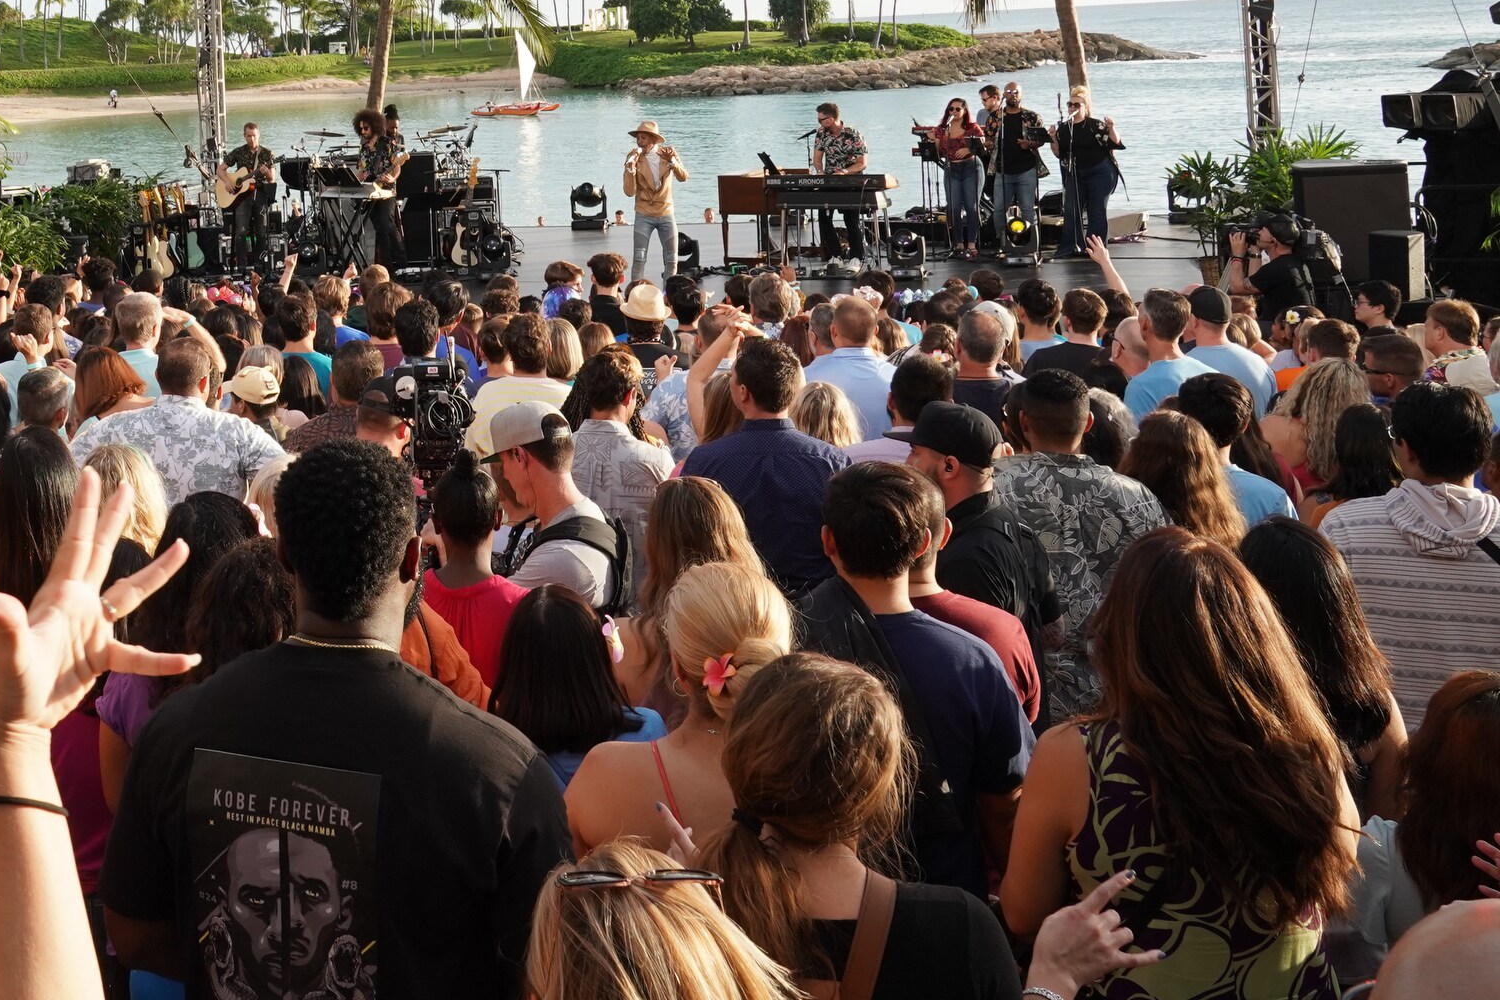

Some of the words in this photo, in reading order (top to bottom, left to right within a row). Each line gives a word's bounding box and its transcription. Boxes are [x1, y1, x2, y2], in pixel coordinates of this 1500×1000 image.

[213, 788, 257, 812] KOBE
[269, 796, 350, 827] FOREVER
[226, 811, 244, 822] REST
[246, 814, 255, 824] IN
[256, 816, 279, 828] PEACE
[281, 820, 305, 832] BLACK
[308, 824, 336, 837] MAMBA
[341, 879, 358, 891] #8
